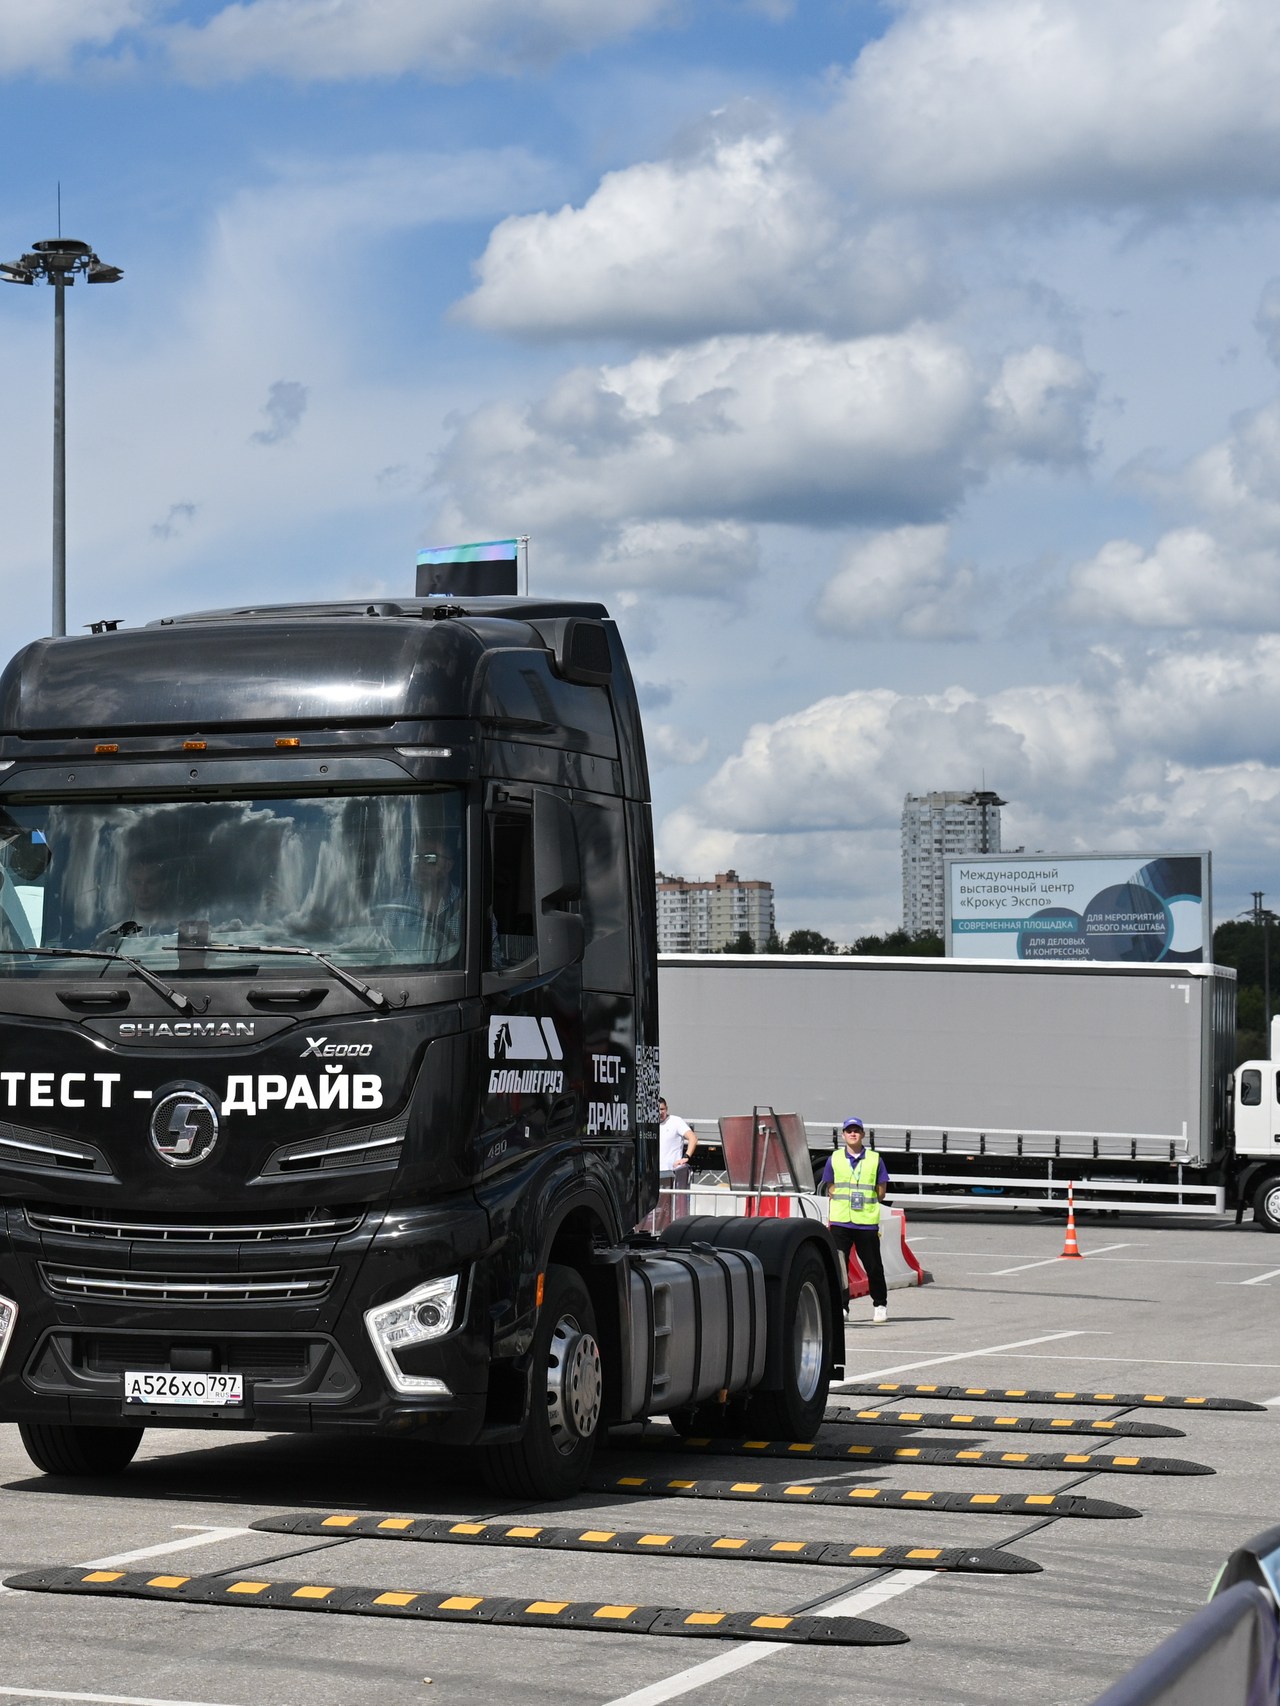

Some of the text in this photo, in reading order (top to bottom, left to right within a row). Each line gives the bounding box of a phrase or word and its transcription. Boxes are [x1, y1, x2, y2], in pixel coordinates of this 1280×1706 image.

[959, 869, 1059, 882] Международный
[959, 883, 1075, 896] выставочный центр
[959, 896, 1052, 909] «Крокус Экспо»
[1086, 912, 1165, 922] ДЛЯ МЕРОПРИЯТИЙ
[958, 920, 1074, 931] СОВРЕМЕННАЯ ПЛОЩАДКА
[1086, 923, 1166, 932] ЛЮБОГО МАСШТАБА
[1029, 938, 1086, 946] ДЛЯ ДЕЛОВЫХ
[1025, 948, 1090, 956] И КОНГРЕССНЫХ
[119, 1022, 255, 1038] SHACMAN
[300, 1037, 373, 1057] X6000
[592, 1054, 626, 1084] ТЕСТ-
[488, 1069, 564, 1094] БОЛЬШЕГРУЗ
[221, 1064, 383, 1116] ДРАЙВ
[587, 1095, 629, 1135] ДРАЙВ
[487, 1139, 508, 1158] 480
[208, 1376, 238, 1392] 797
